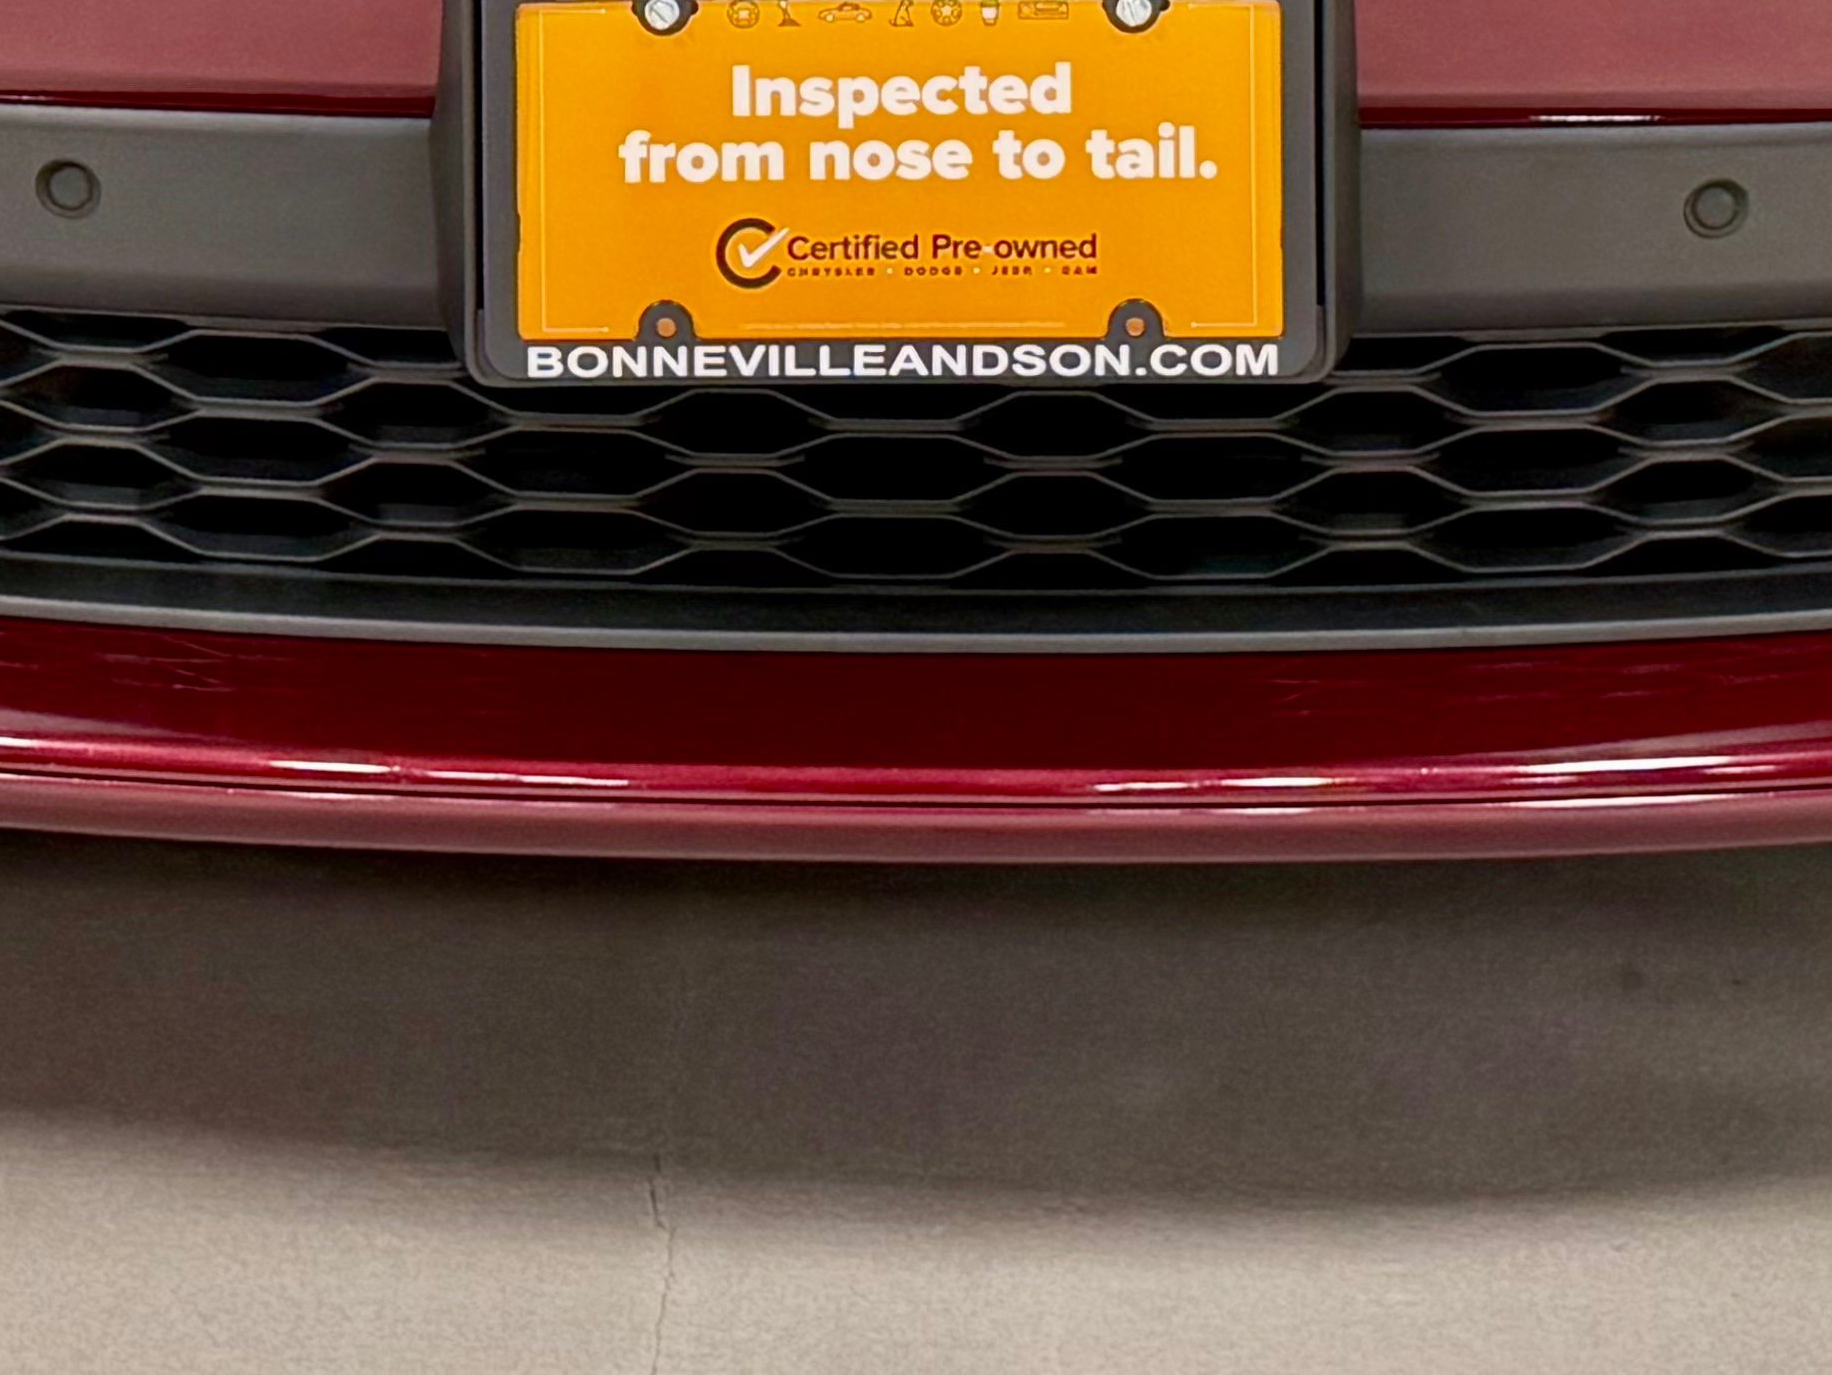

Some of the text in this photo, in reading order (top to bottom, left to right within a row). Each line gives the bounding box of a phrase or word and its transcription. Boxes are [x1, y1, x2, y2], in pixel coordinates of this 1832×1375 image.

[731, 62, 1073, 128] Inspected
[618, 123, 1218, 183] from nose to tail.
[786, 234, 919, 261] Certified
[526, 342, 1280, 379] BONNEVILLEANDSON.COM
